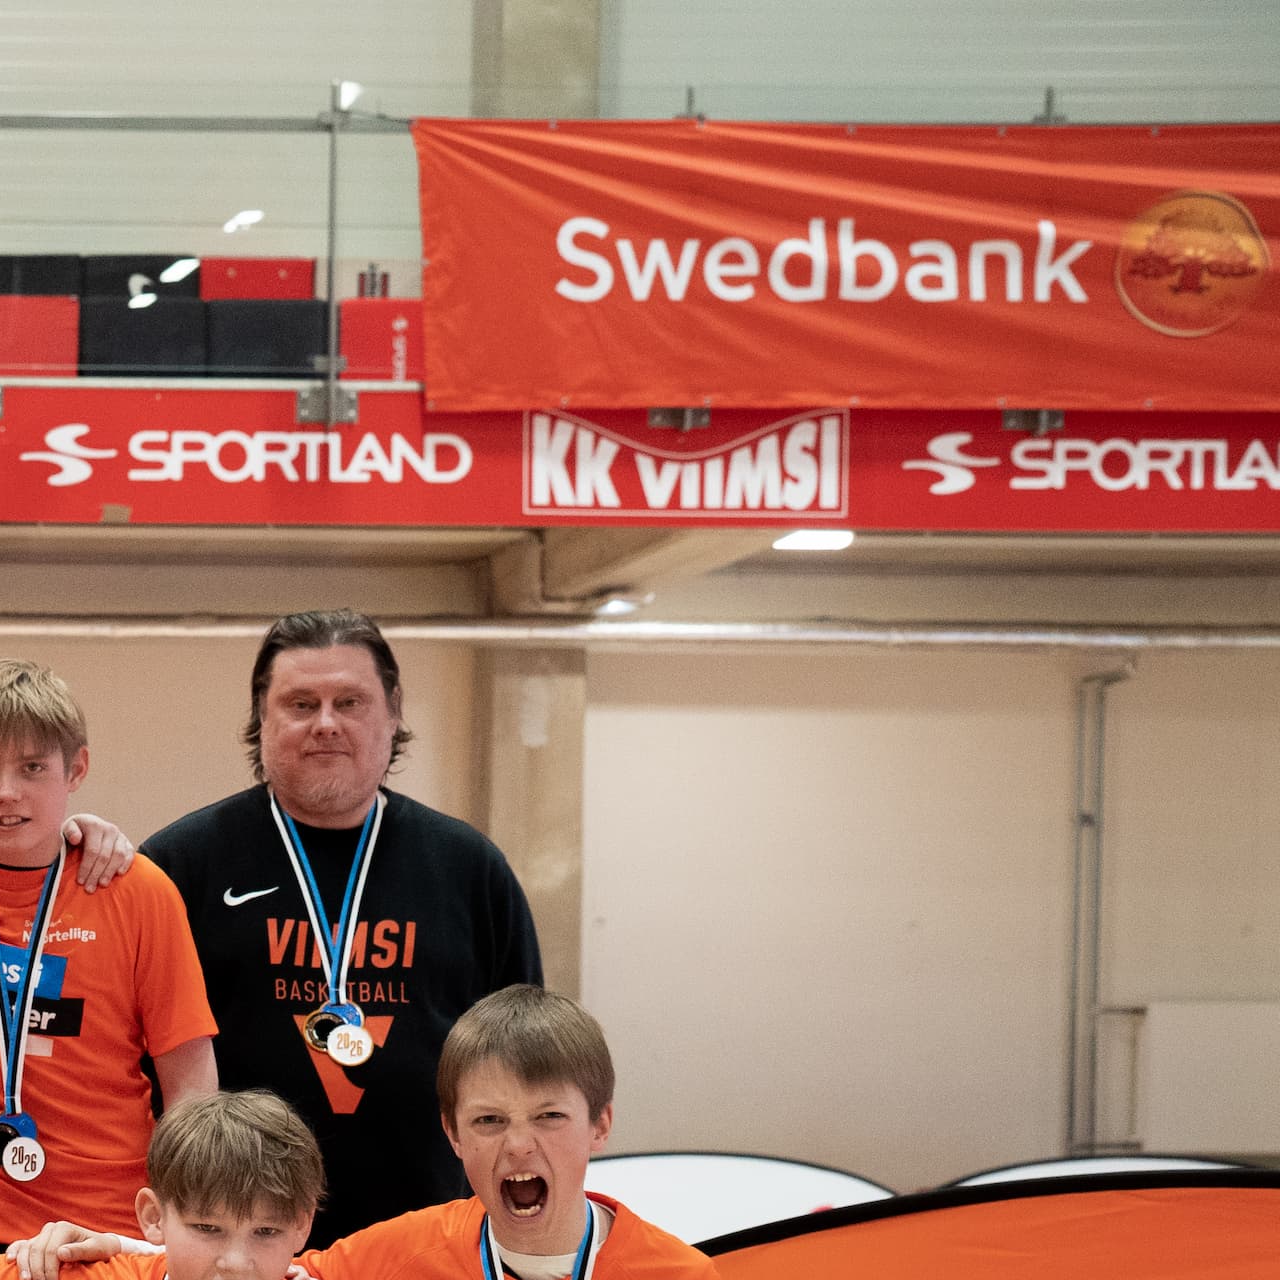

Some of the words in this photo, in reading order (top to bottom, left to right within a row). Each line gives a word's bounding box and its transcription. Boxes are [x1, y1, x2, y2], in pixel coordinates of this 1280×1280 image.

[554, 216, 1095, 305] Swedbank
[127, 430, 474, 484] SPORTLAND
[531, 413, 621, 508] KK
[635, 414, 838, 511] VIIMSI
[1008, 437, 1280, 493] SPORTLA
[274, 978, 410, 1004] BASKTBALL
[12, 1146, 24, 1166] 20
[24, 1153, 37, 1173] 26
